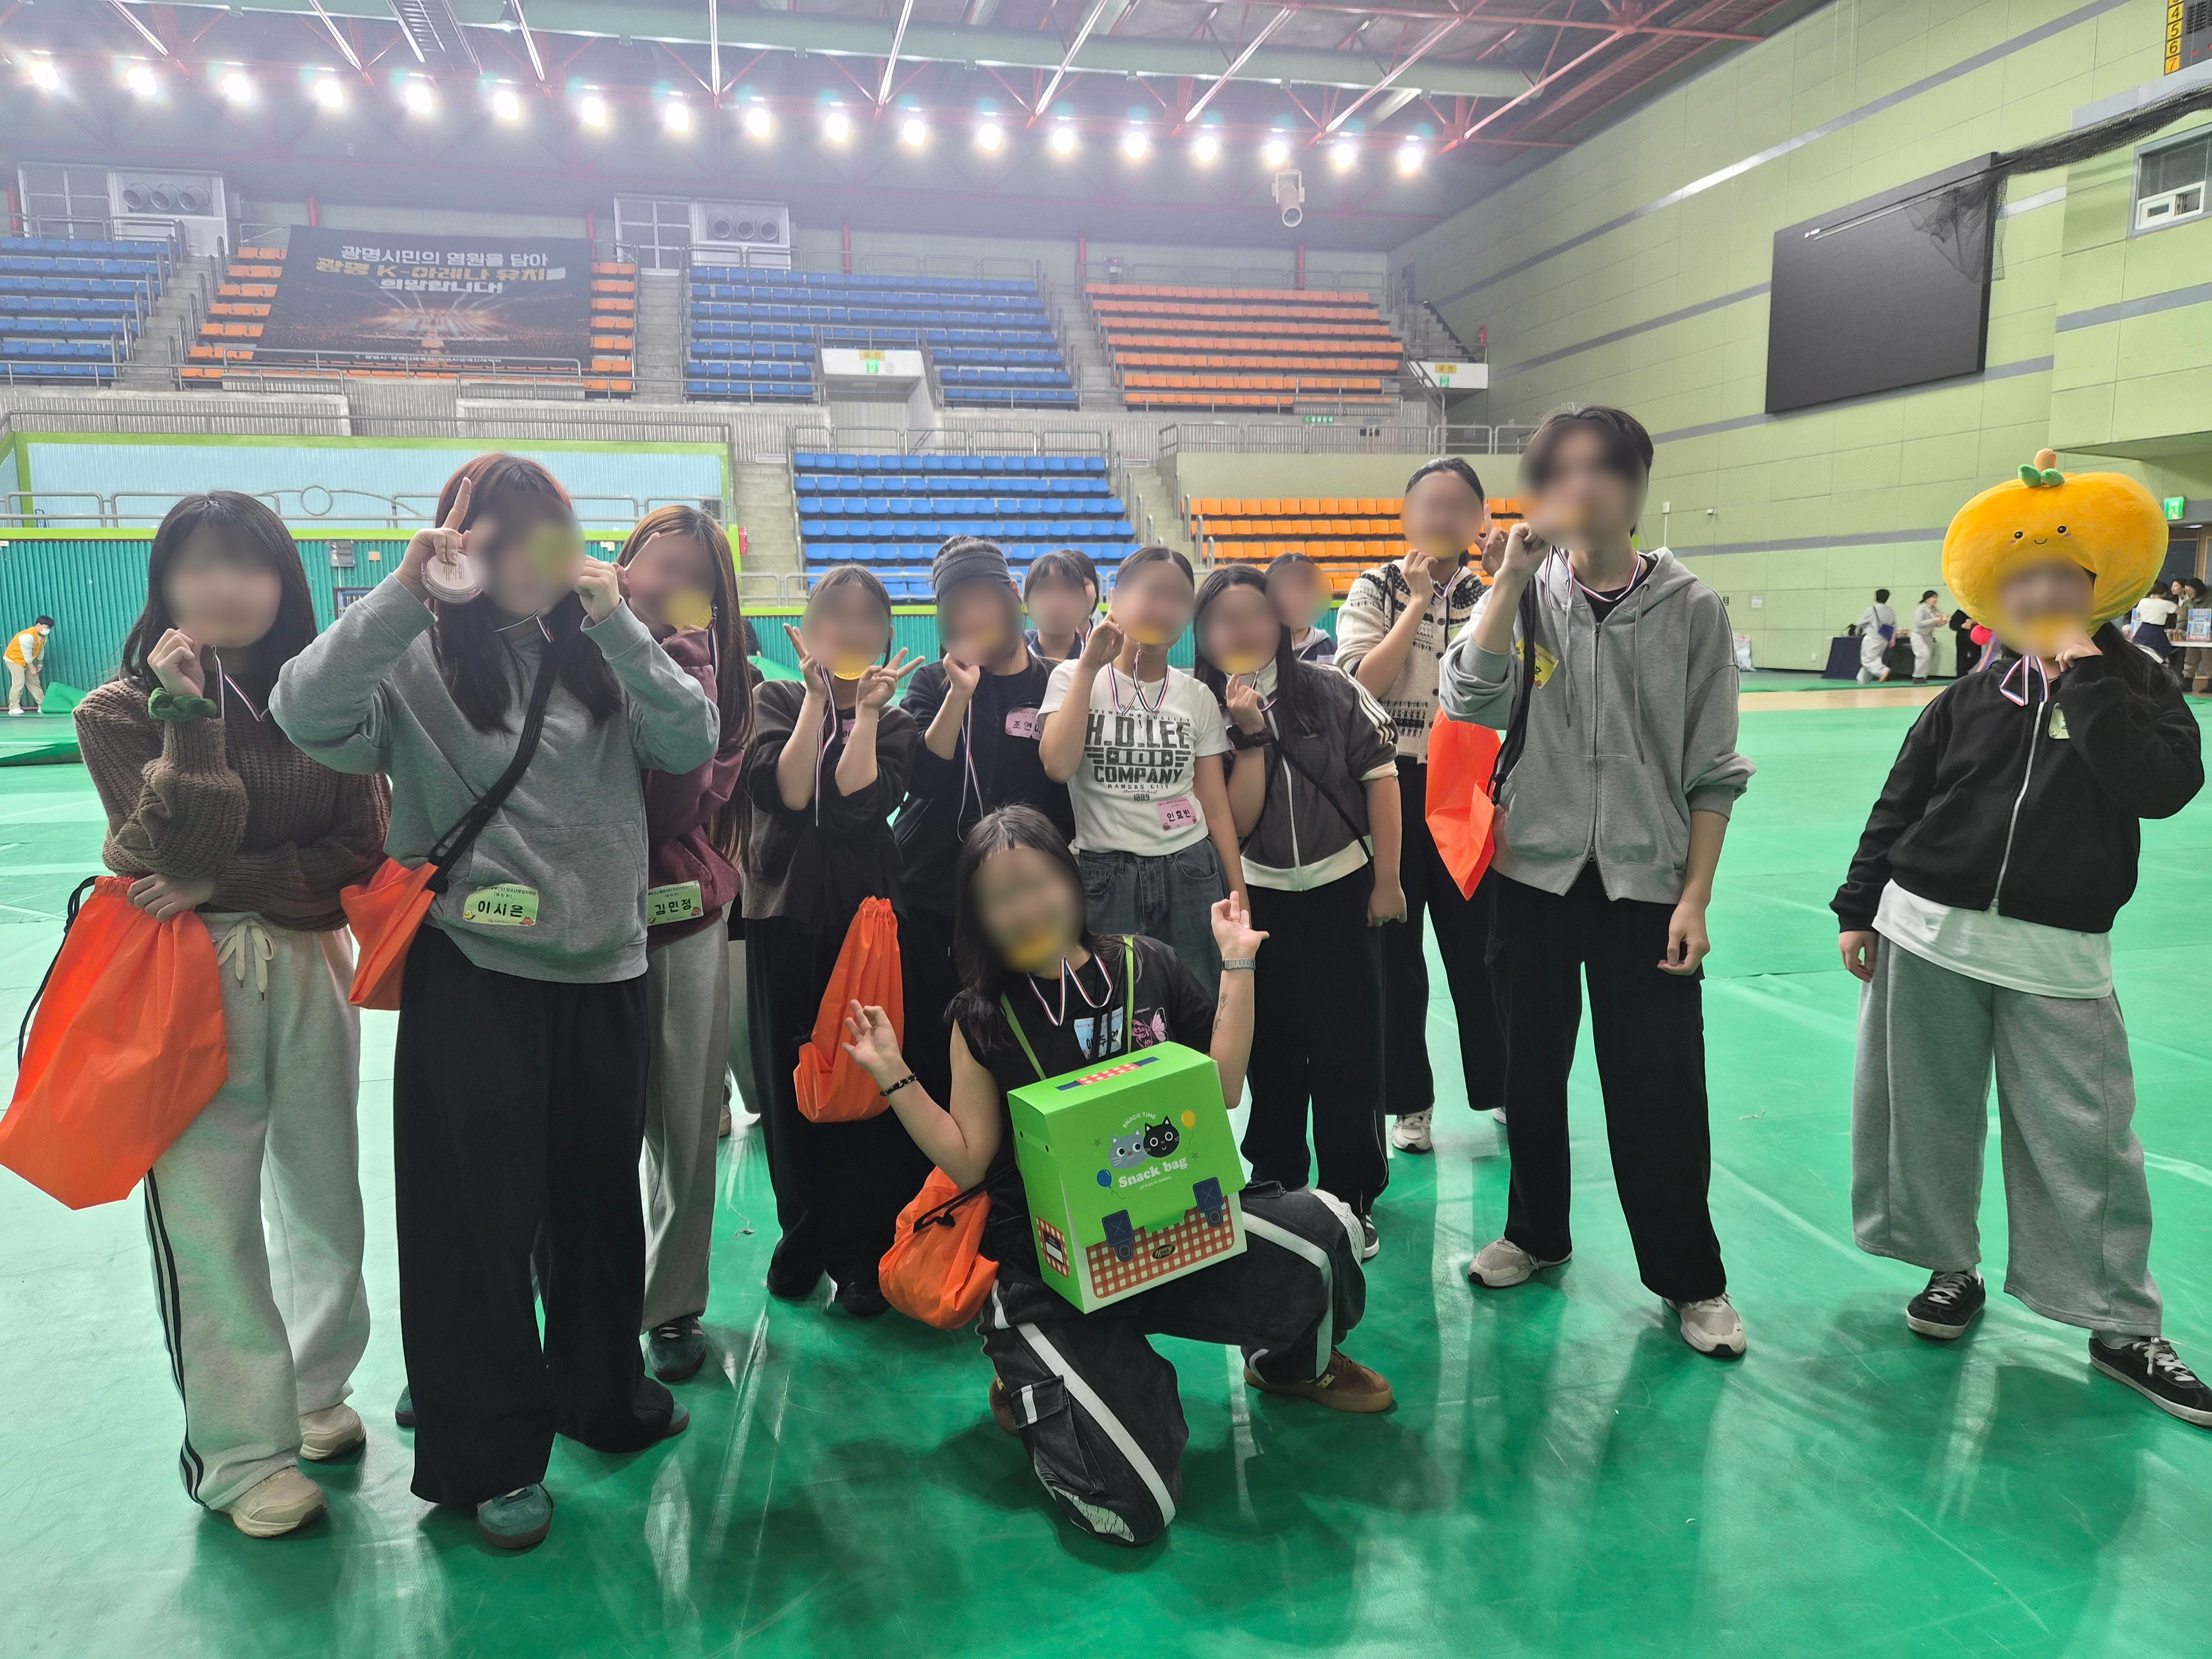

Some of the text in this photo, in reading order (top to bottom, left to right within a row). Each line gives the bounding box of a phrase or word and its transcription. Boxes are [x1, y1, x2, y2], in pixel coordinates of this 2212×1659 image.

[2171, 6, 2180, 19] 4
[2171, 23, 2179, 37] 5
[2169, 41, 2178, 54] 6
[2169, 58, 2177, 71] 7
[340, 245, 549, 267] 광명시민의 염원을 담아
[316, 257, 566, 281] 광명 K-아레나 유치를
[379, 279, 503, 294] 희망합니다!
[1094, 765, 1183, 784] COMPANY
[478, 900, 523, 917] 이시은
[654, 898, 692, 916] 김민정
[1123, 1113, 1141, 1129] SNACK
[1118, 1157, 1188, 1188] Snack bag
